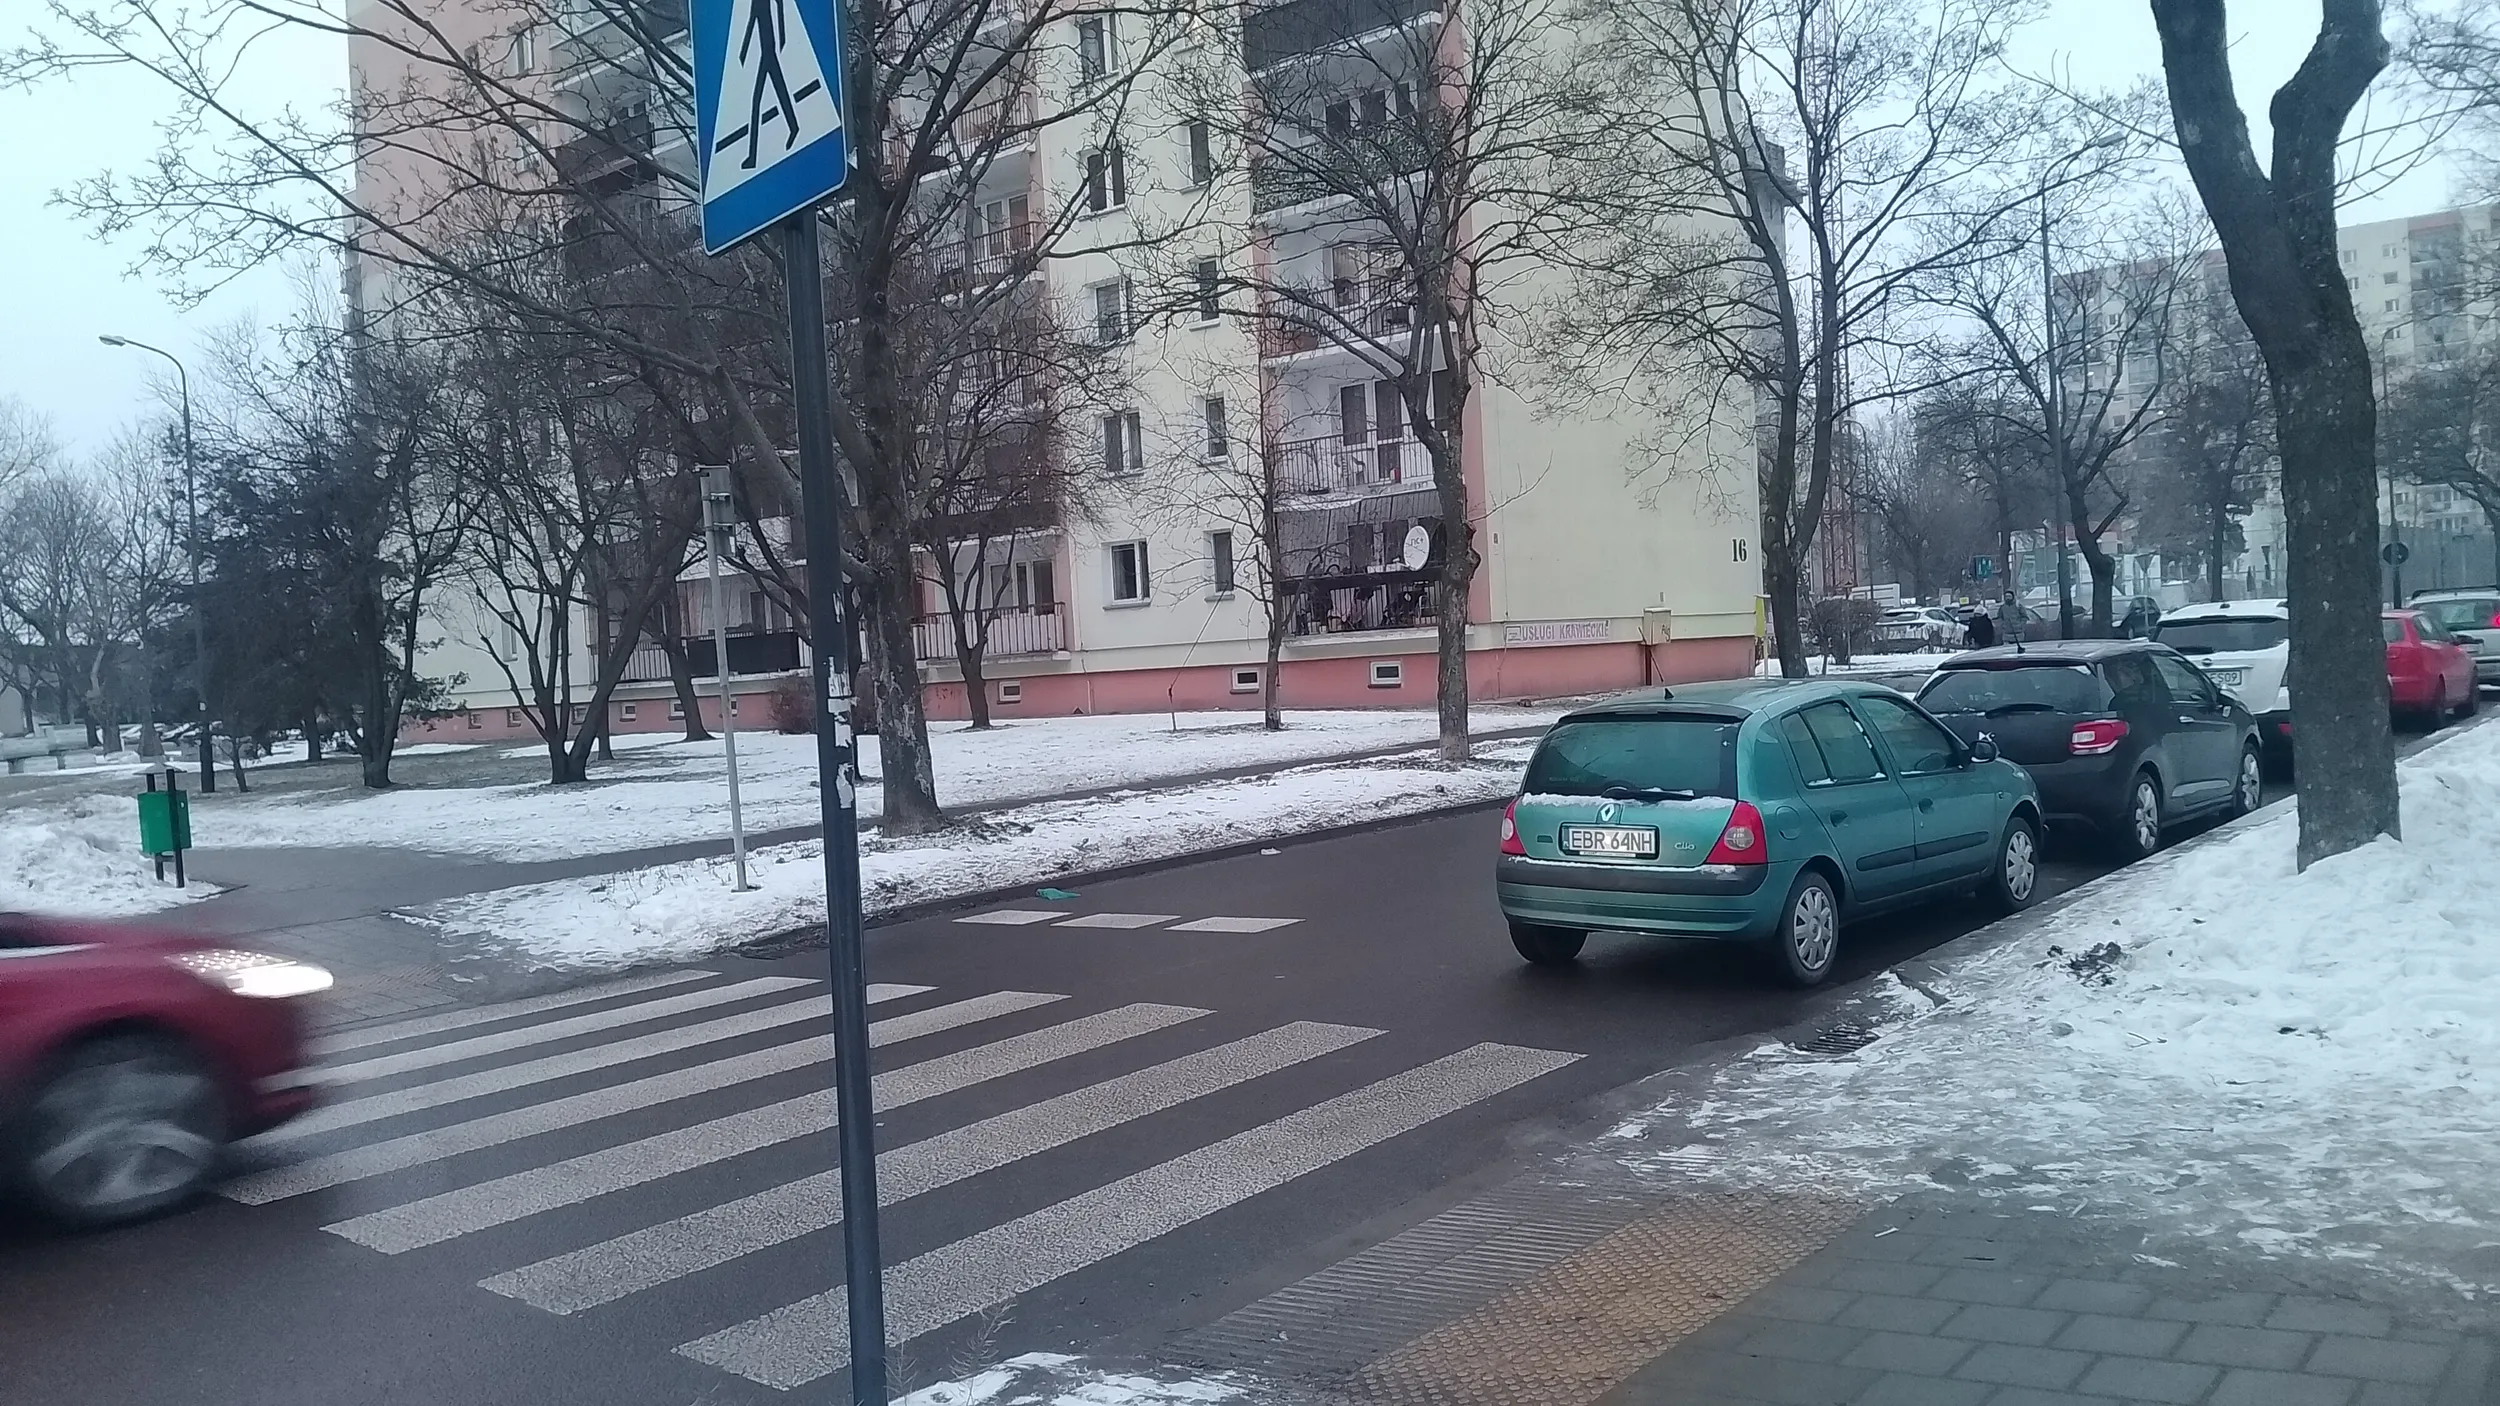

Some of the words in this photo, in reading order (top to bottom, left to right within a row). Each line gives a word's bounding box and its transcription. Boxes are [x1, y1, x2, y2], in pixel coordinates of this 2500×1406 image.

[1732, 538, 1747, 562] 16
[1572, 830, 1605, 850] EBR
[1610, 831, 1653, 852] 64NH
